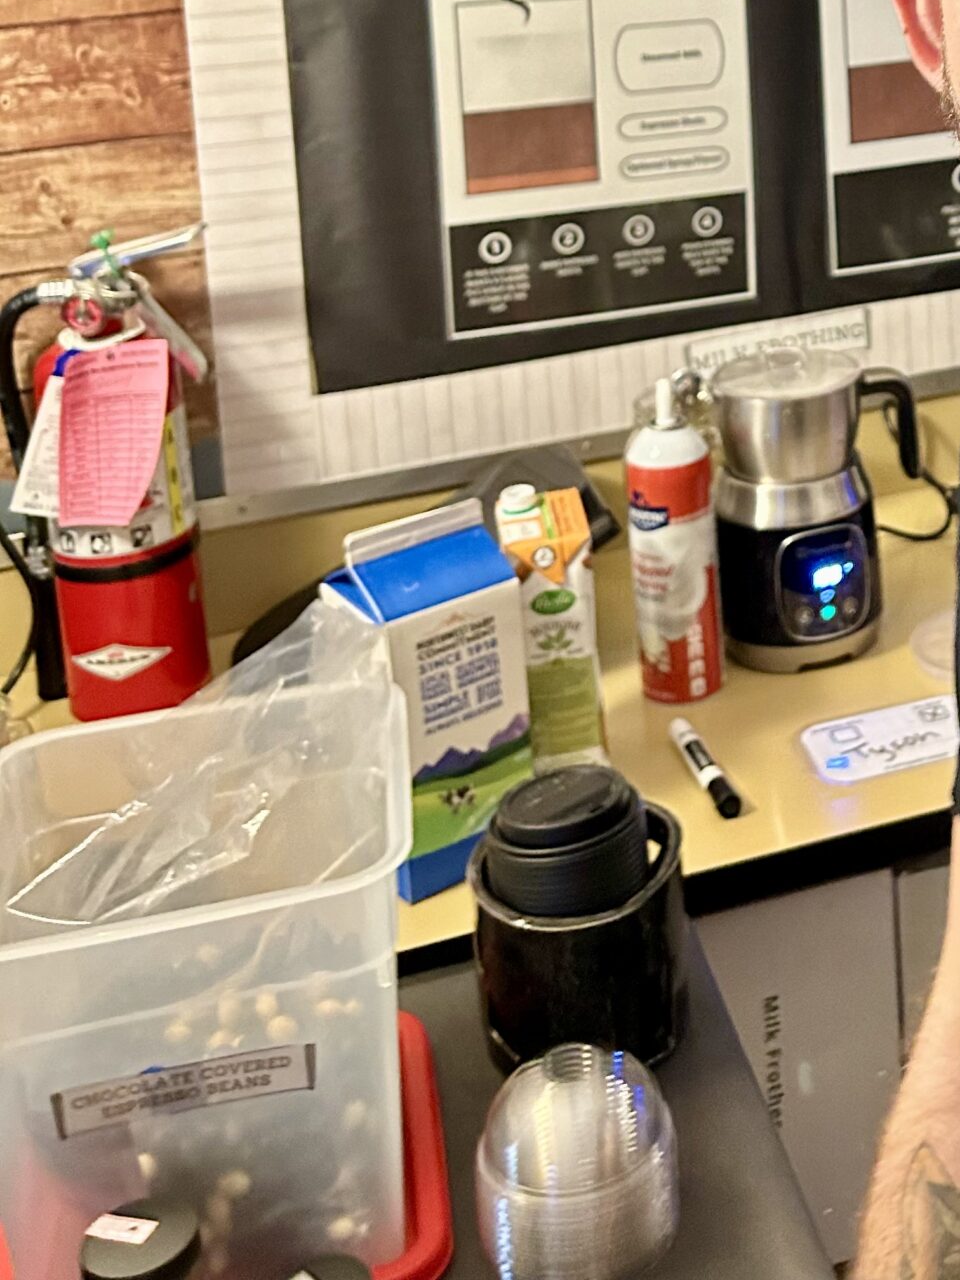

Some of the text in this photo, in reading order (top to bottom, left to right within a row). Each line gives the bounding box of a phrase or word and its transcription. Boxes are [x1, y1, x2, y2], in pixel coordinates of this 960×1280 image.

[763, 995, 781, 1043] Milk
[71, 1055, 292, 1110] CHOCOLATE COVERED
[206, 1073, 272, 1095] BEANS
[766, 1048, 785, 1129] Frother
